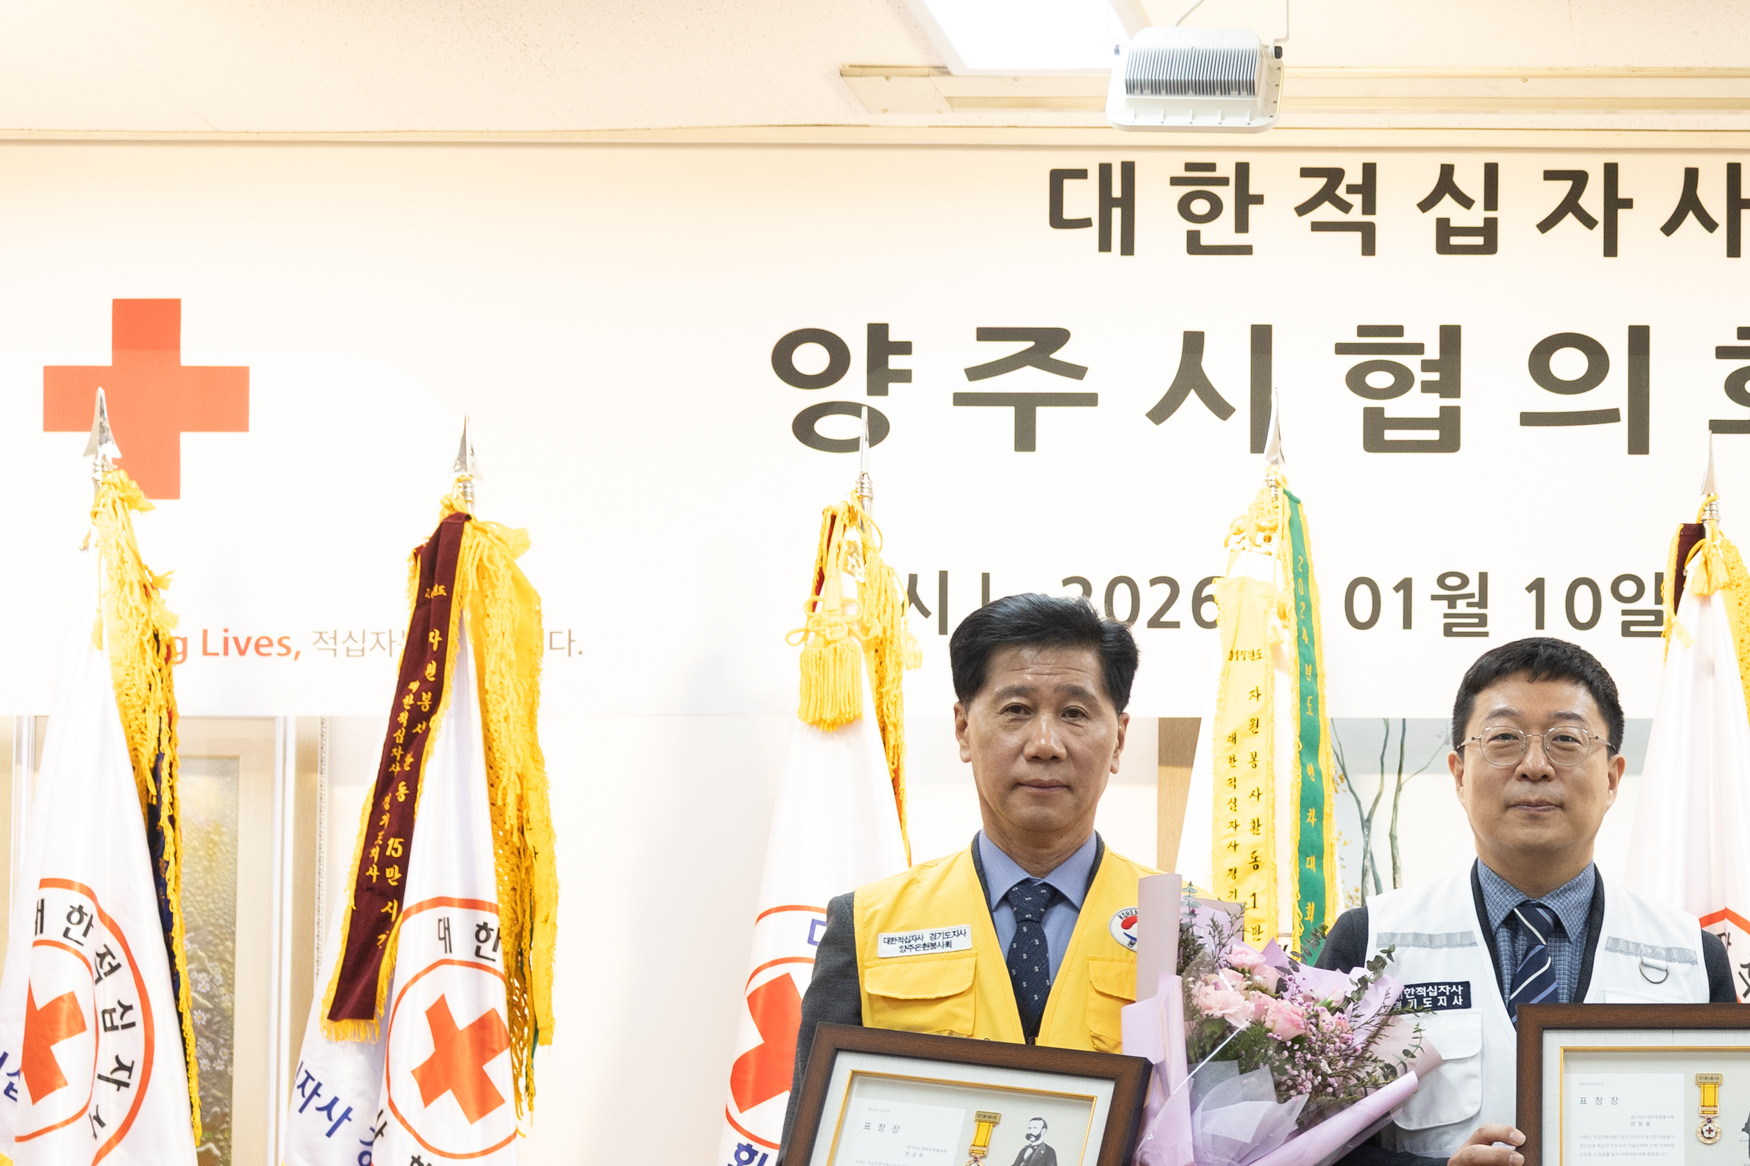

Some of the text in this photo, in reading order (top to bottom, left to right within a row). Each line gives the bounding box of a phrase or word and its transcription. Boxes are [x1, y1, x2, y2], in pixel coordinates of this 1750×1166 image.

[1344, 571, 1490, 638] 01월
[202, 627, 301, 661] Lives,
[313, 629, 406, 658] 적십자
[1117, 909, 1138, 920] KOREA
[883, 928, 967, 945] 대한적십자사 경기도지사
[1398, 995, 1464, 1010] 기도지사
